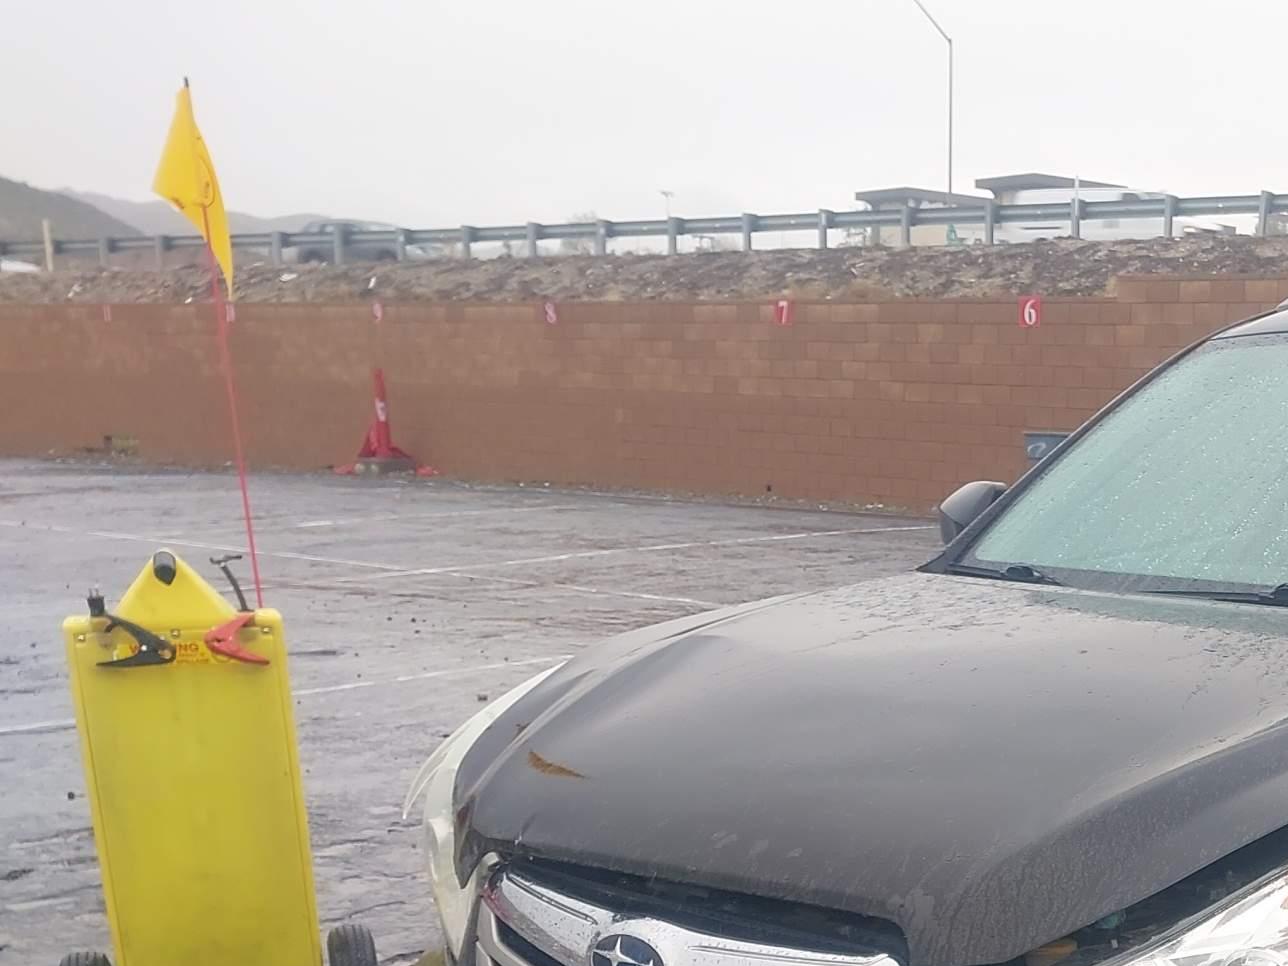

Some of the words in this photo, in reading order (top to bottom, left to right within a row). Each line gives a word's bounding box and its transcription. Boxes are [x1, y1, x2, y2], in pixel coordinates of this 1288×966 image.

[545, 301, 557, 323] 8
[778, 301, 788, 325] 7
[1023, 299, 1036, 325] 6
